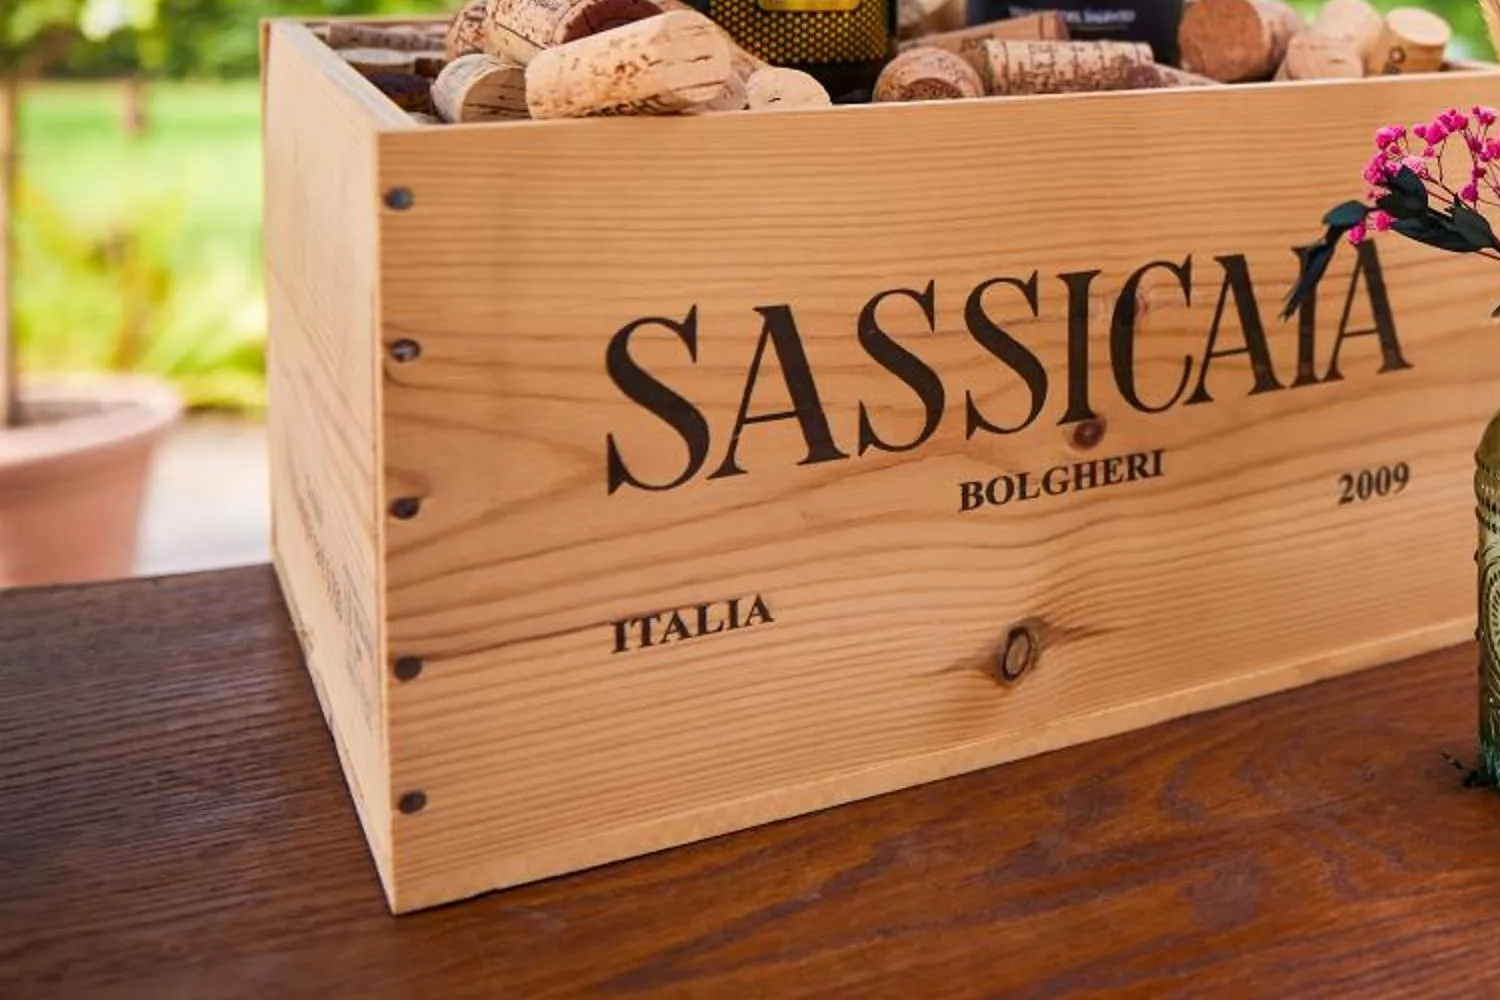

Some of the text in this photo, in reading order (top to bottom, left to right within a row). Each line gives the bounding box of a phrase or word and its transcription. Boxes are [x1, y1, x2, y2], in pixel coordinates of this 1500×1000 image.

[605, 237, 1414, 496] SASSICAIA
[957, 448, 1411, 513] BOLGHERI 2009
[610, 592, 776, 655] ITALIA
